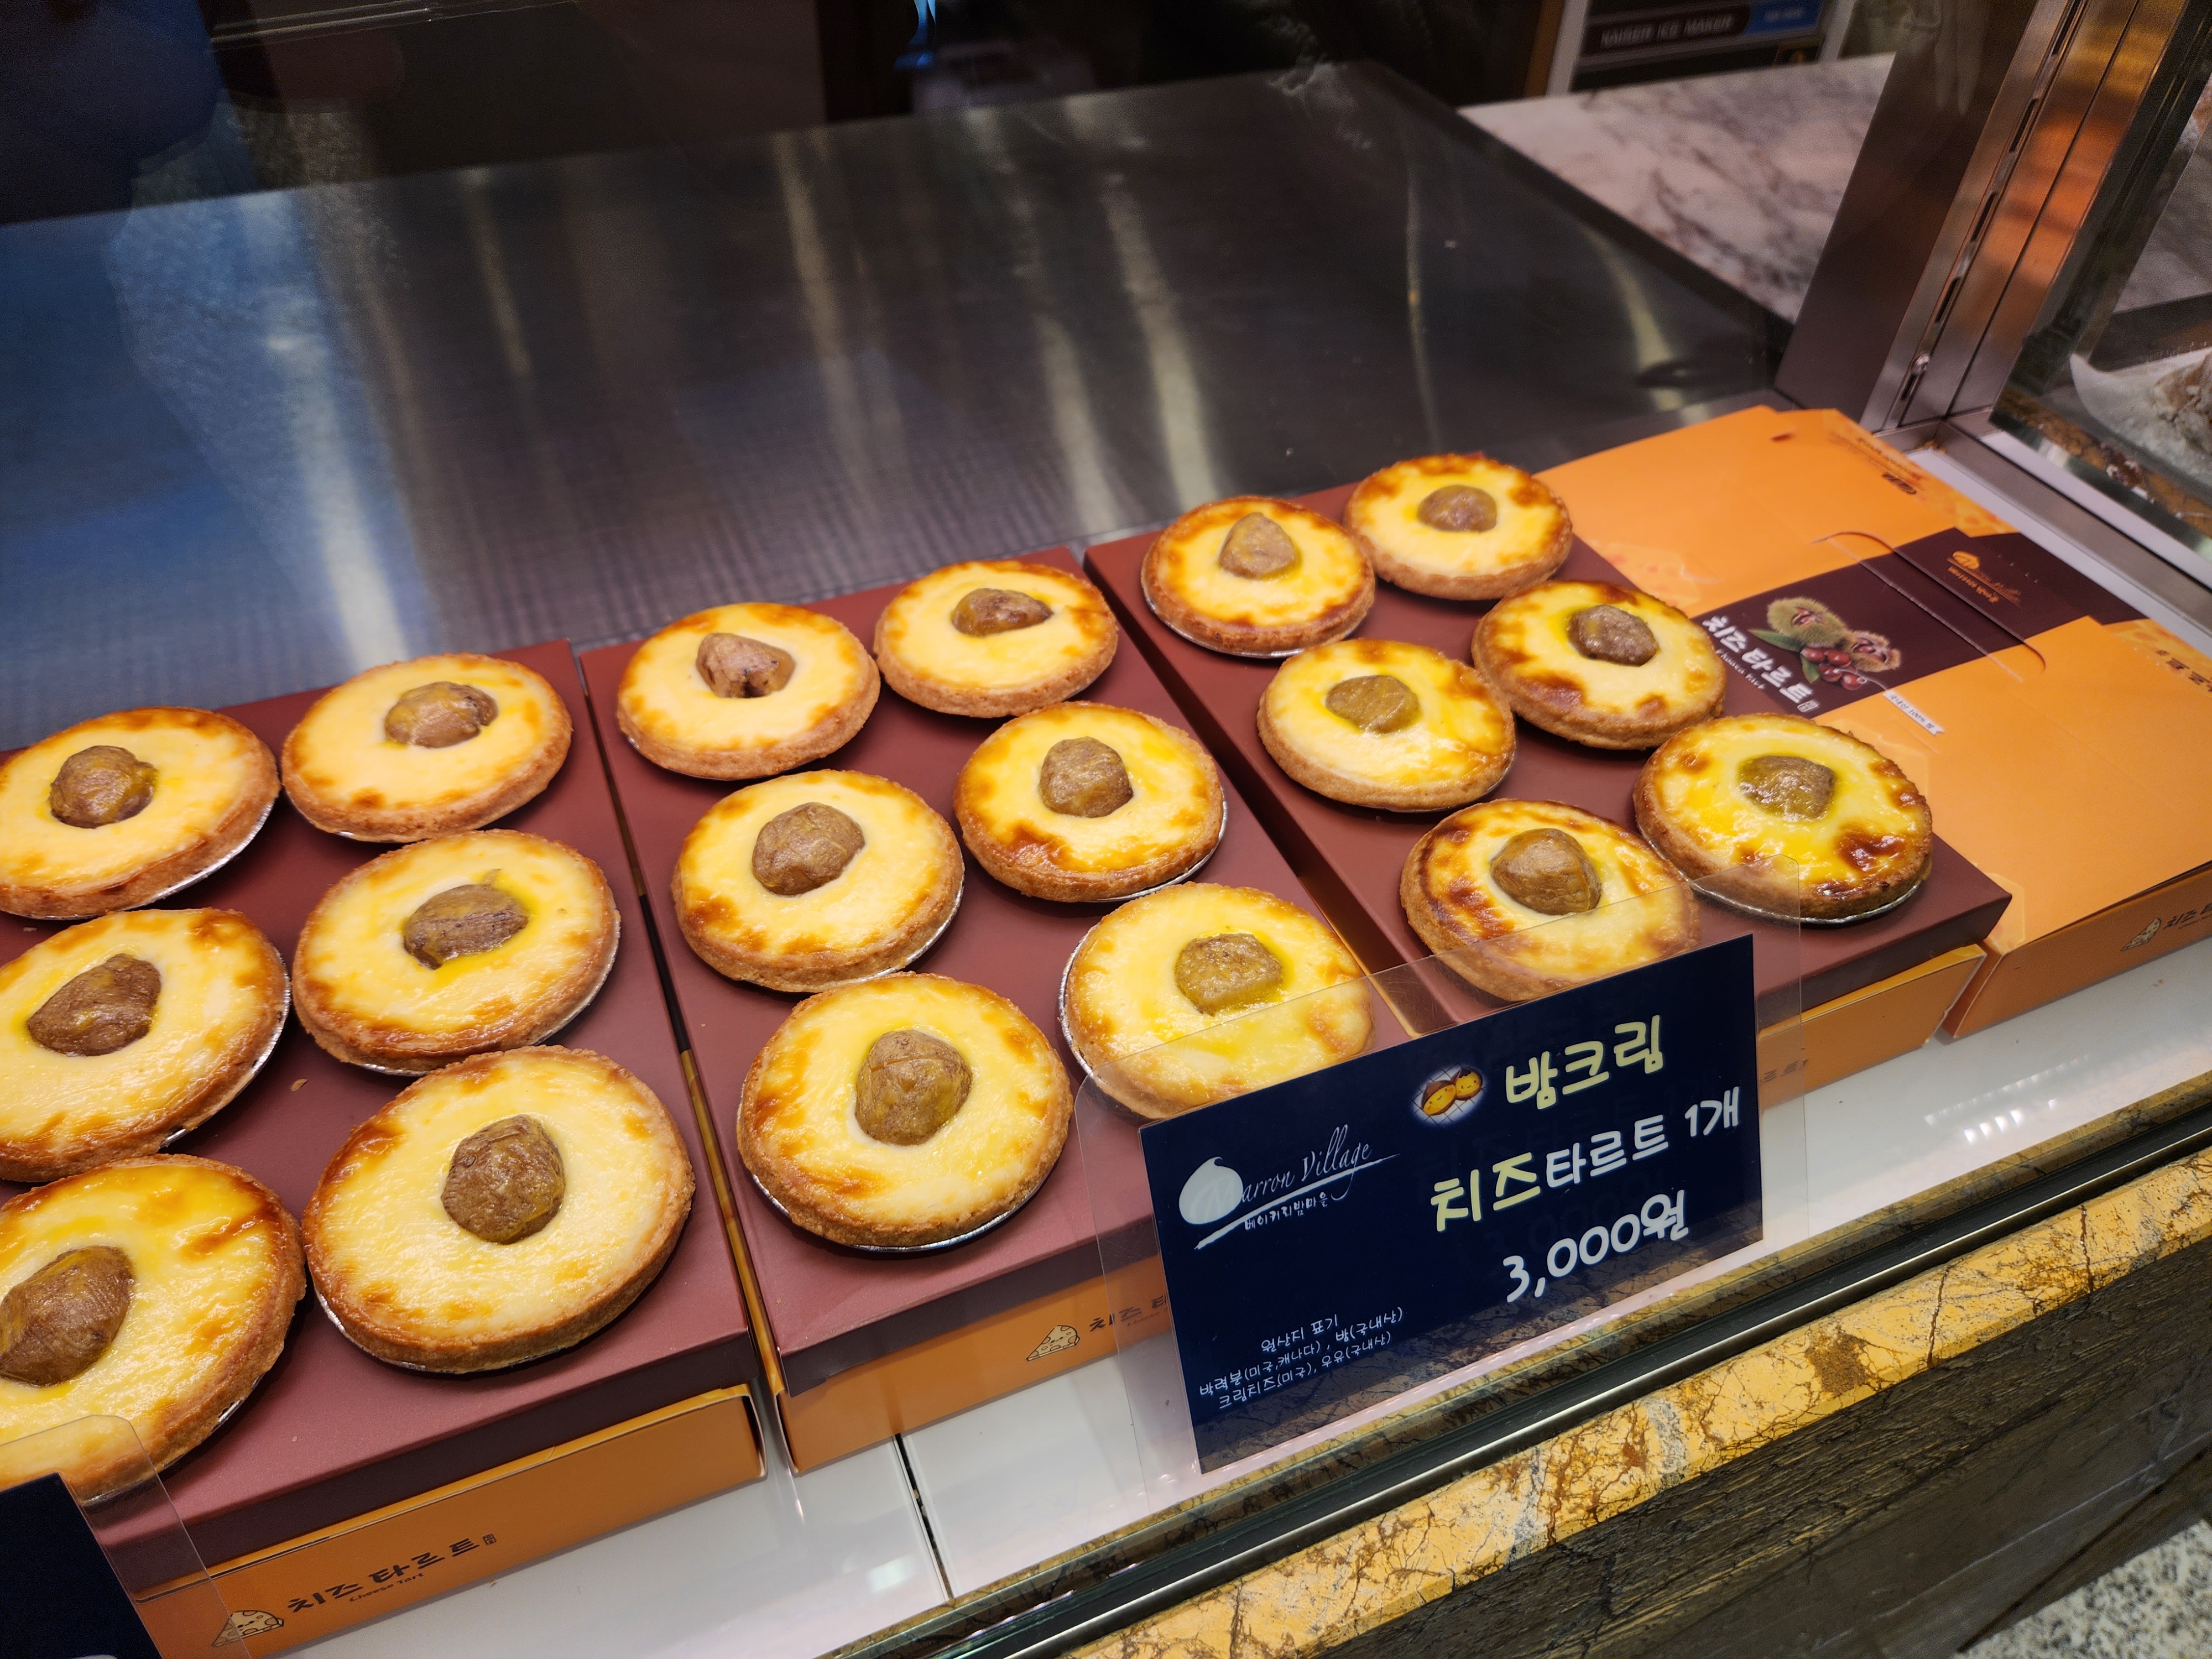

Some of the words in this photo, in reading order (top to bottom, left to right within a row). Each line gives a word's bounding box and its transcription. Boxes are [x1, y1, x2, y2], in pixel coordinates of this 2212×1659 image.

[1702, 615, 1747, 653] 치즈
[1741, 647, 1814, 703] 타르트
[1505, 1015, 1663, 1110] 밤크림
[1301, 1124, 1372, 1201] Village
[1430, 1114, 1668, 1232] 치즈타르트
[1684, 1086, 1740, 1137] 1개
[1503, 1189, 1689, 1303] 3,000원
[1089, 1306, 1142, 1333] 치즈
[1261, 1327, 1305, 1353] 원산지
[1310, 1313, 1338, 1335] 표기
[1321, 1331, 1391, 1368] 우유(국내산)
[288, 1583, 363, 1613] 치즈
[368, 1537, 480, 1584] 타르트
[349, 1584, 394, 1602] Cheese
[396, 1572, 425, 1584] Tart
